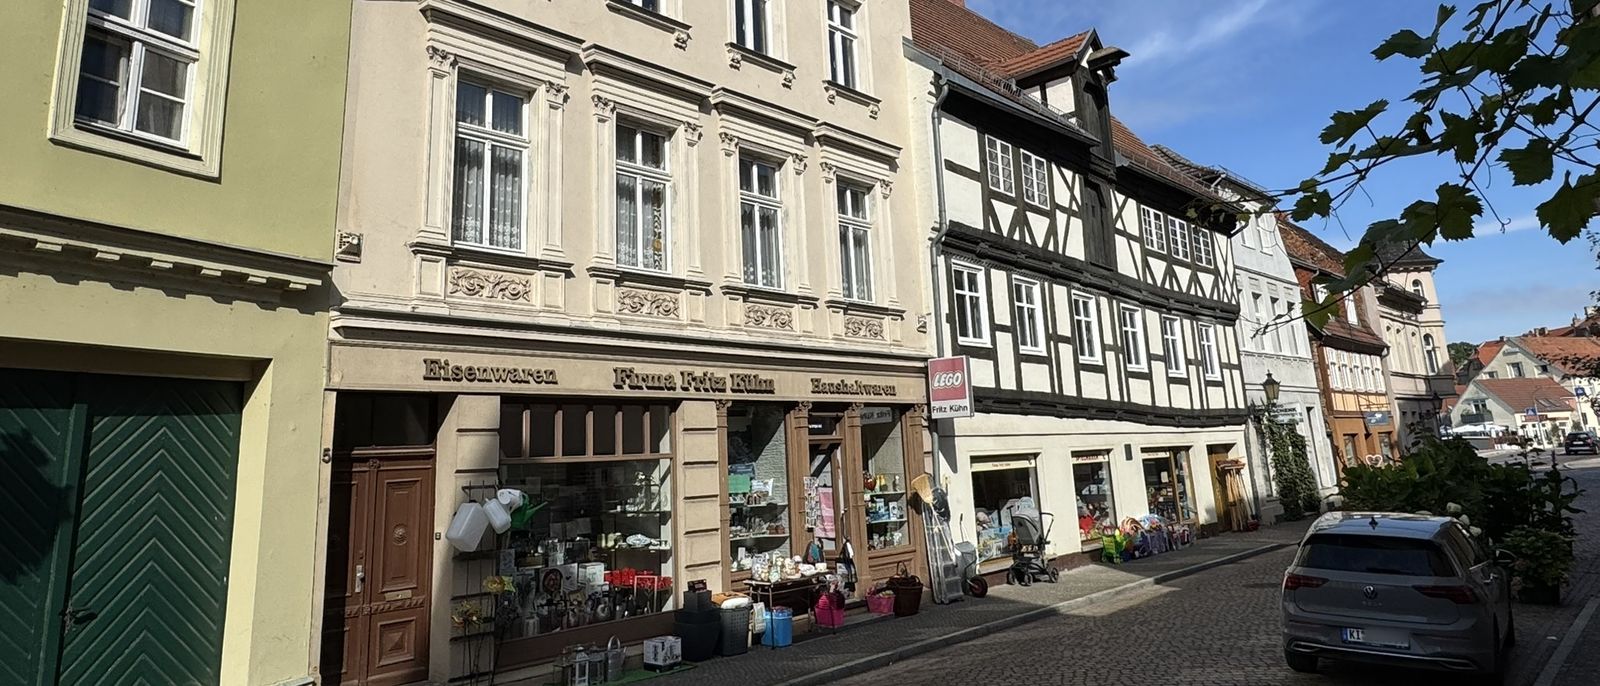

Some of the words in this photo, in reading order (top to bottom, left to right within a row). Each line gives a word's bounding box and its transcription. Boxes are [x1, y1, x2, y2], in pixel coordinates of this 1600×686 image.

[423, 358, 558, 384] Eisenwaren
[932, 371, 963, 388] LEGO
[613, 367, 676, 391] Firma
[680, 371, 726, 393] Fritz
[730, 373, 775, 394] Kühn
[811, 378, 896, 396] Haushaltwaren
[950, 404, 968, 412] Kühn
[321, 448, 331, 464] 5
[1349, 629, 1361, 640] KI
